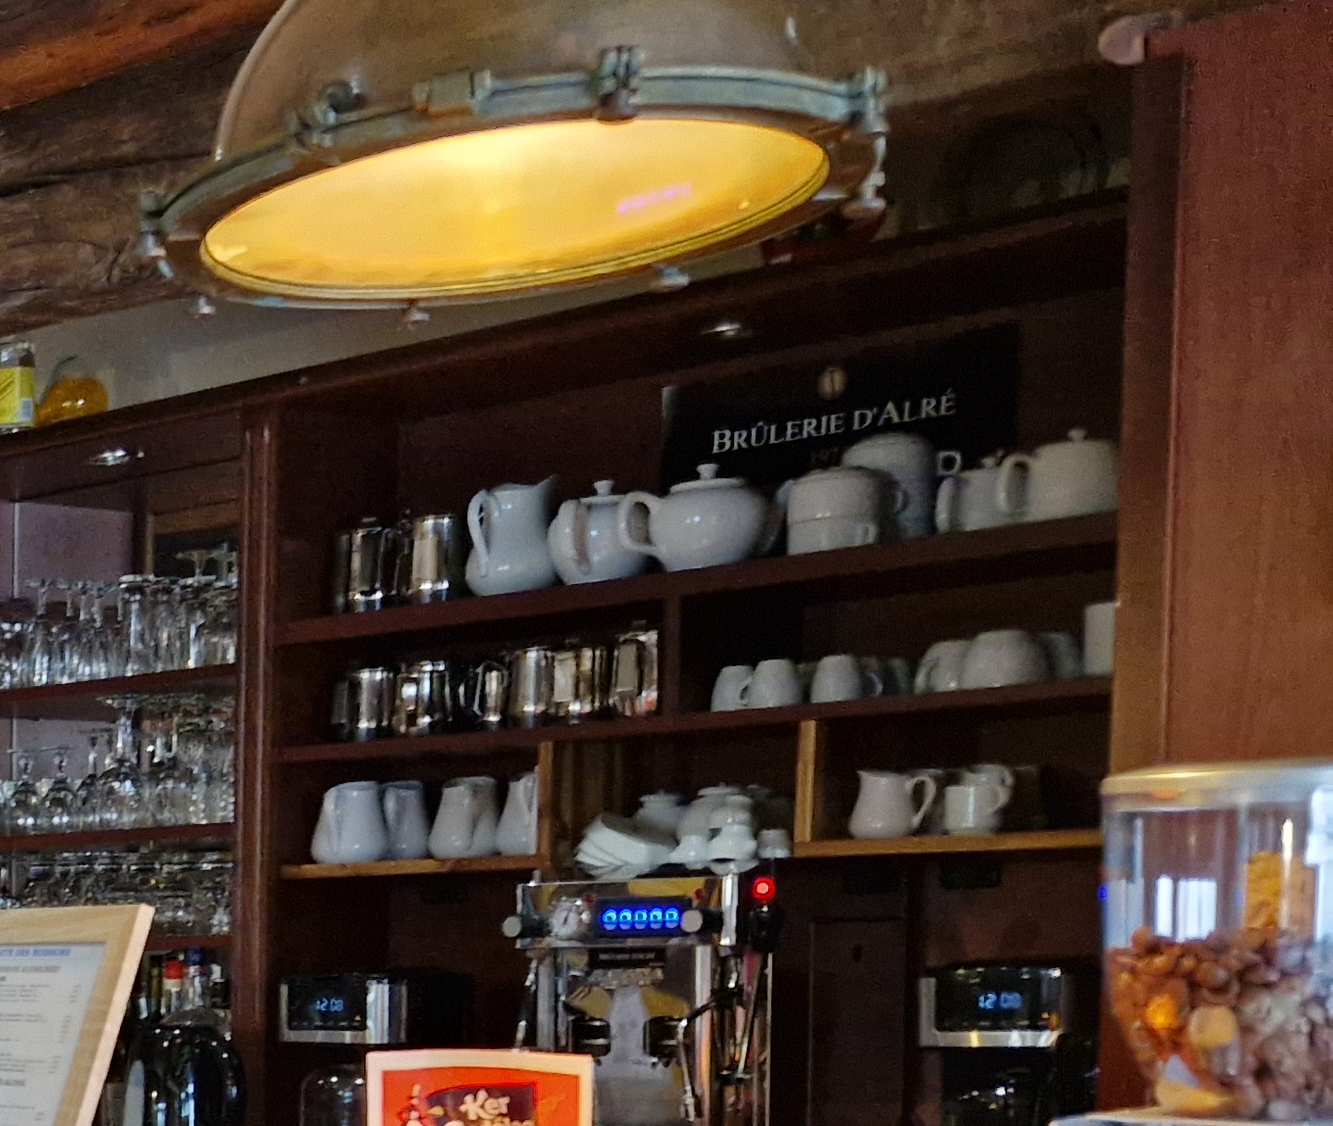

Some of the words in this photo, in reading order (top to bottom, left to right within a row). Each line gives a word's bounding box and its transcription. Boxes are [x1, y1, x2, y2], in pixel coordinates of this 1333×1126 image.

[711, 411, 846, 455] BRÛLERIE
[852, 387, 957, 432] D'ALRÉ
[459, 1088, 510, 1121] Ker
